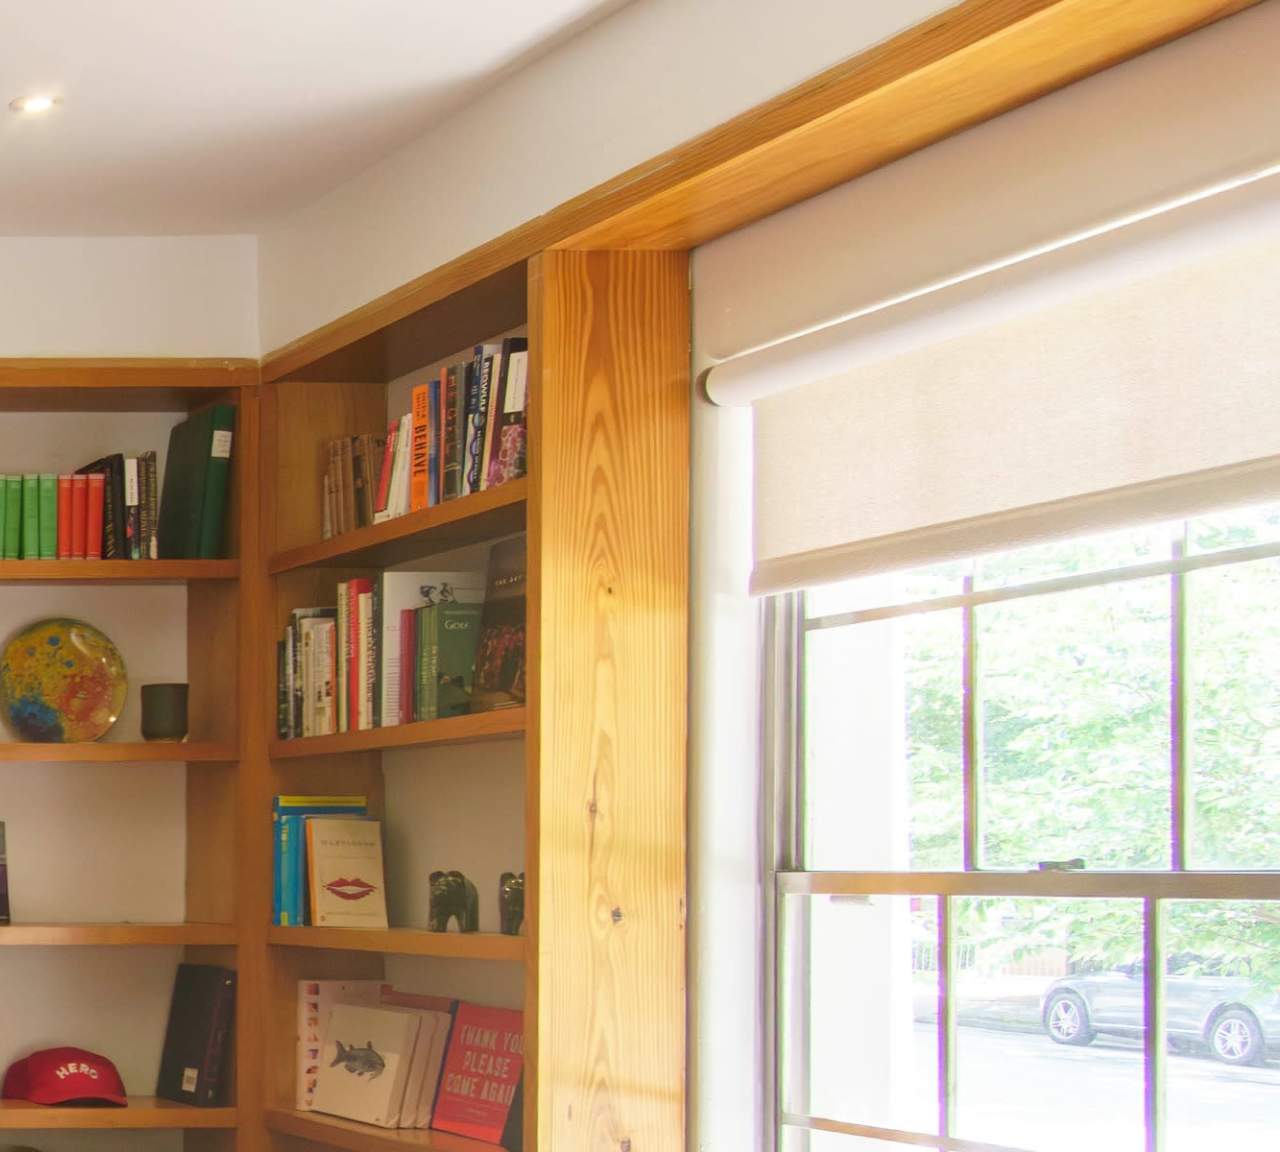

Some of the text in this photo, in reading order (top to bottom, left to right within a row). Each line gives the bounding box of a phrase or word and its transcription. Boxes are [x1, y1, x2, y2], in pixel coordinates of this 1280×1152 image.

[479, 361, 490, 412] BEOWULF
[414, 424, 427, 478] BEHAVE
[460, 1024, 497, 1051] THANK
[55, 1062, 99, 1080] HERO
[462, 1050, 512, 1078] PLEASE
[446, 1072, 477, 1097] COME
